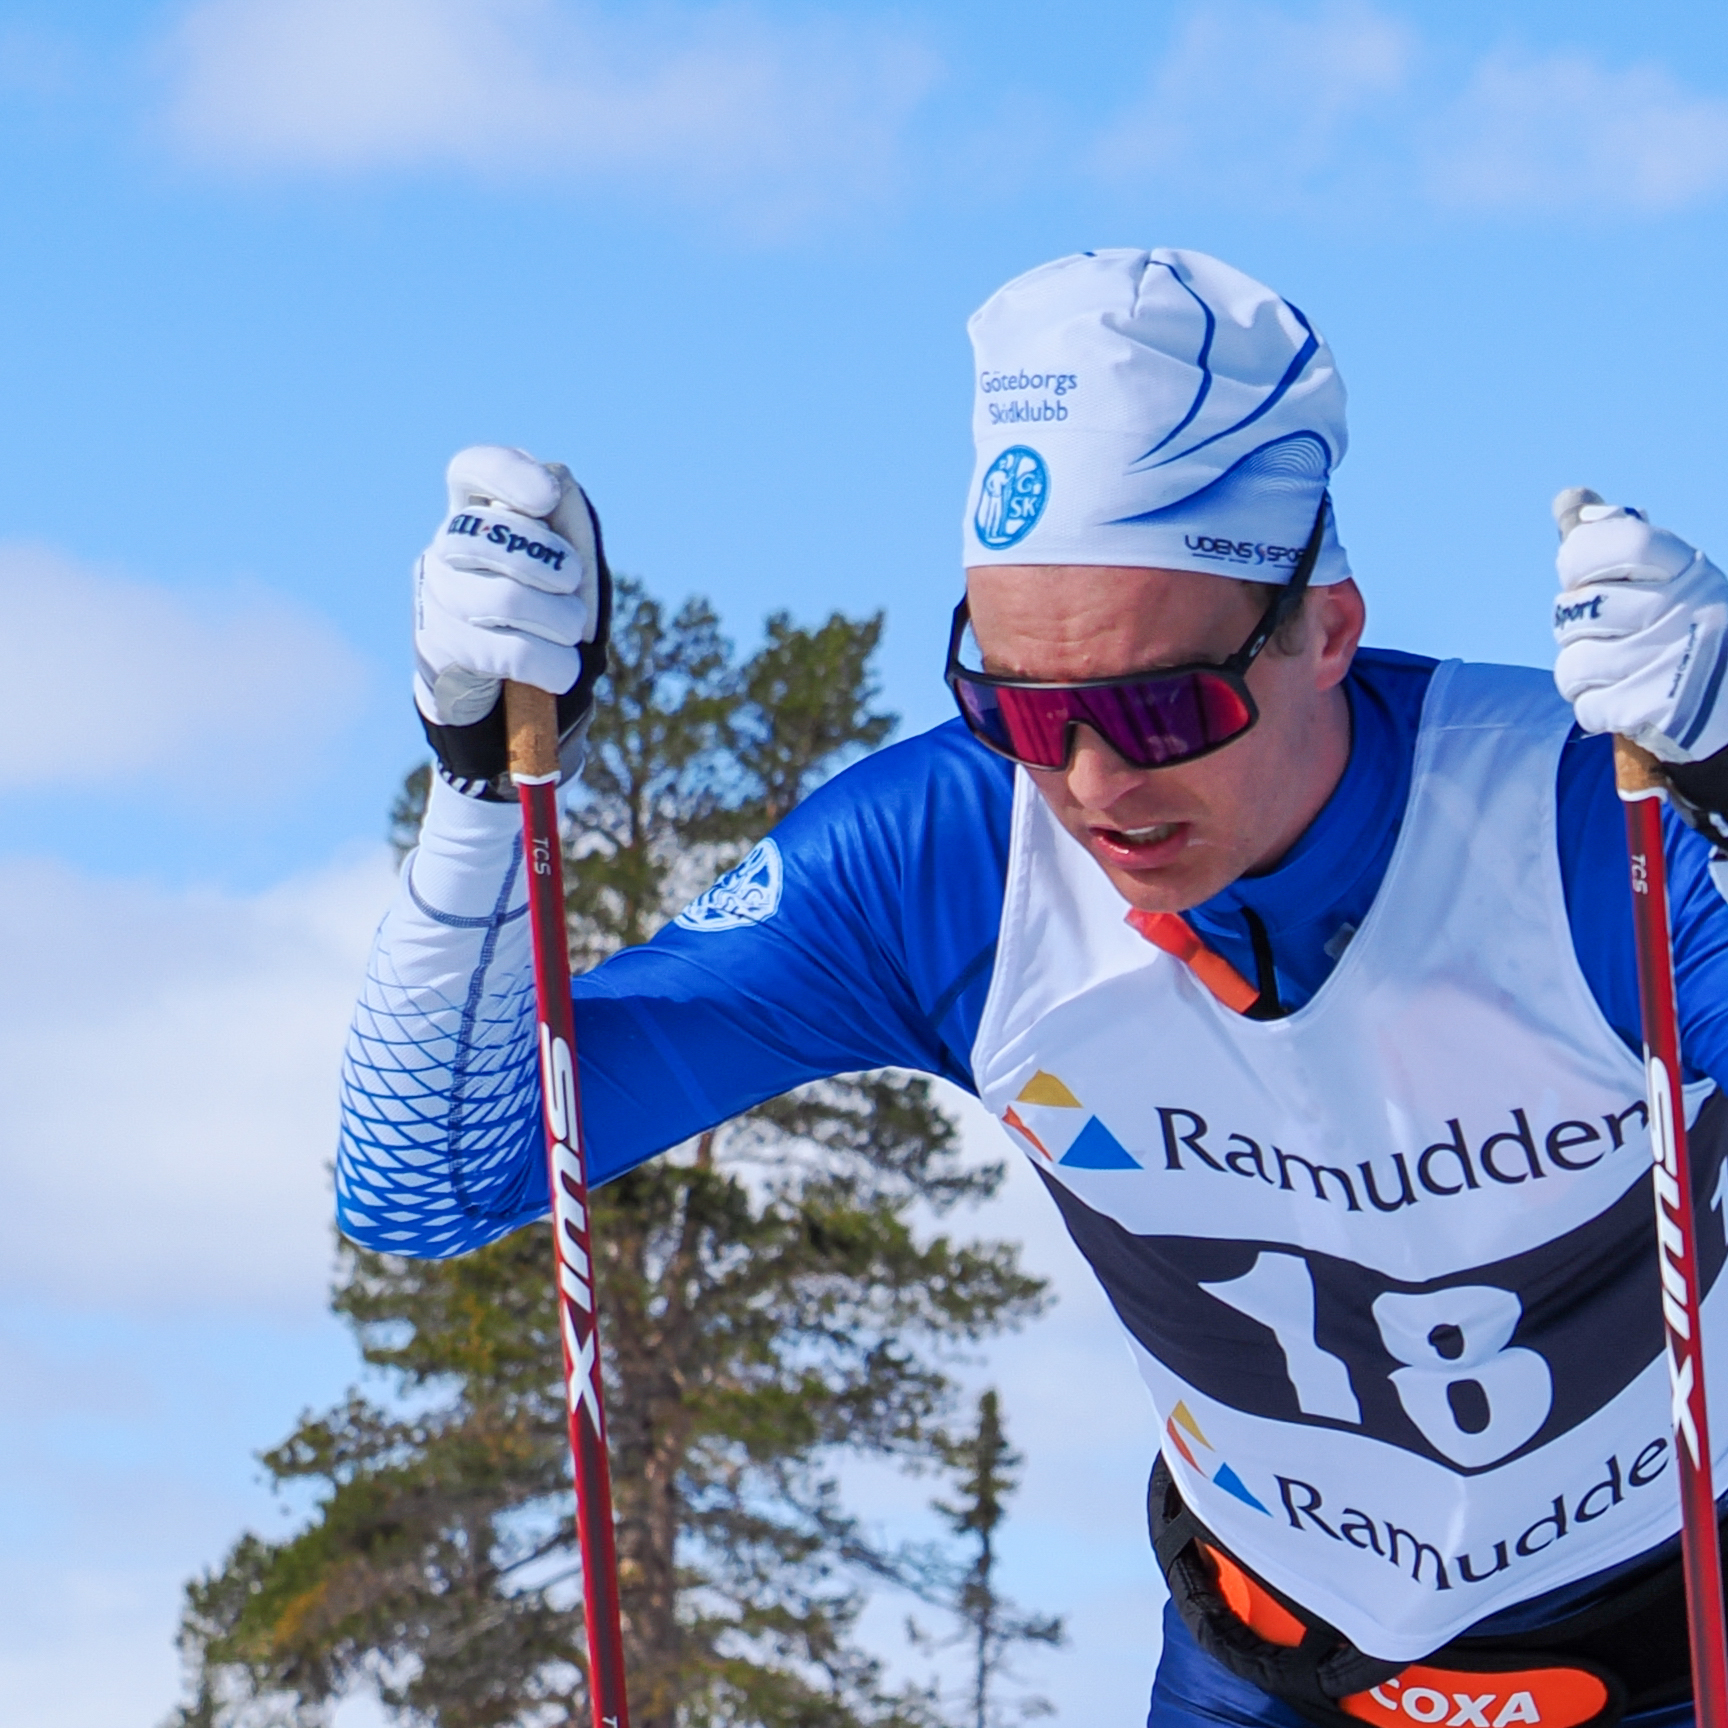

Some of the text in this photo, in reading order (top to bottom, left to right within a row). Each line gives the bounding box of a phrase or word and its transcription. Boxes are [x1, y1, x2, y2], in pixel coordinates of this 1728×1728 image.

[980, 370, 1078, 395] Göteborgs
[988, 400, 1069, 424] Skidklubb
[1010, 496, 1037, 518] SK
[486, 523, 567, 571] Sport
[1184, 534, 1253, 559] UDENS
[531, 837, 551, 876] TCS
[1631, 853, 1648, 895] TCS
[1199, 1250, 1554, 1477] 18
[1272, 1436, 1670, 1592] Ramudde
